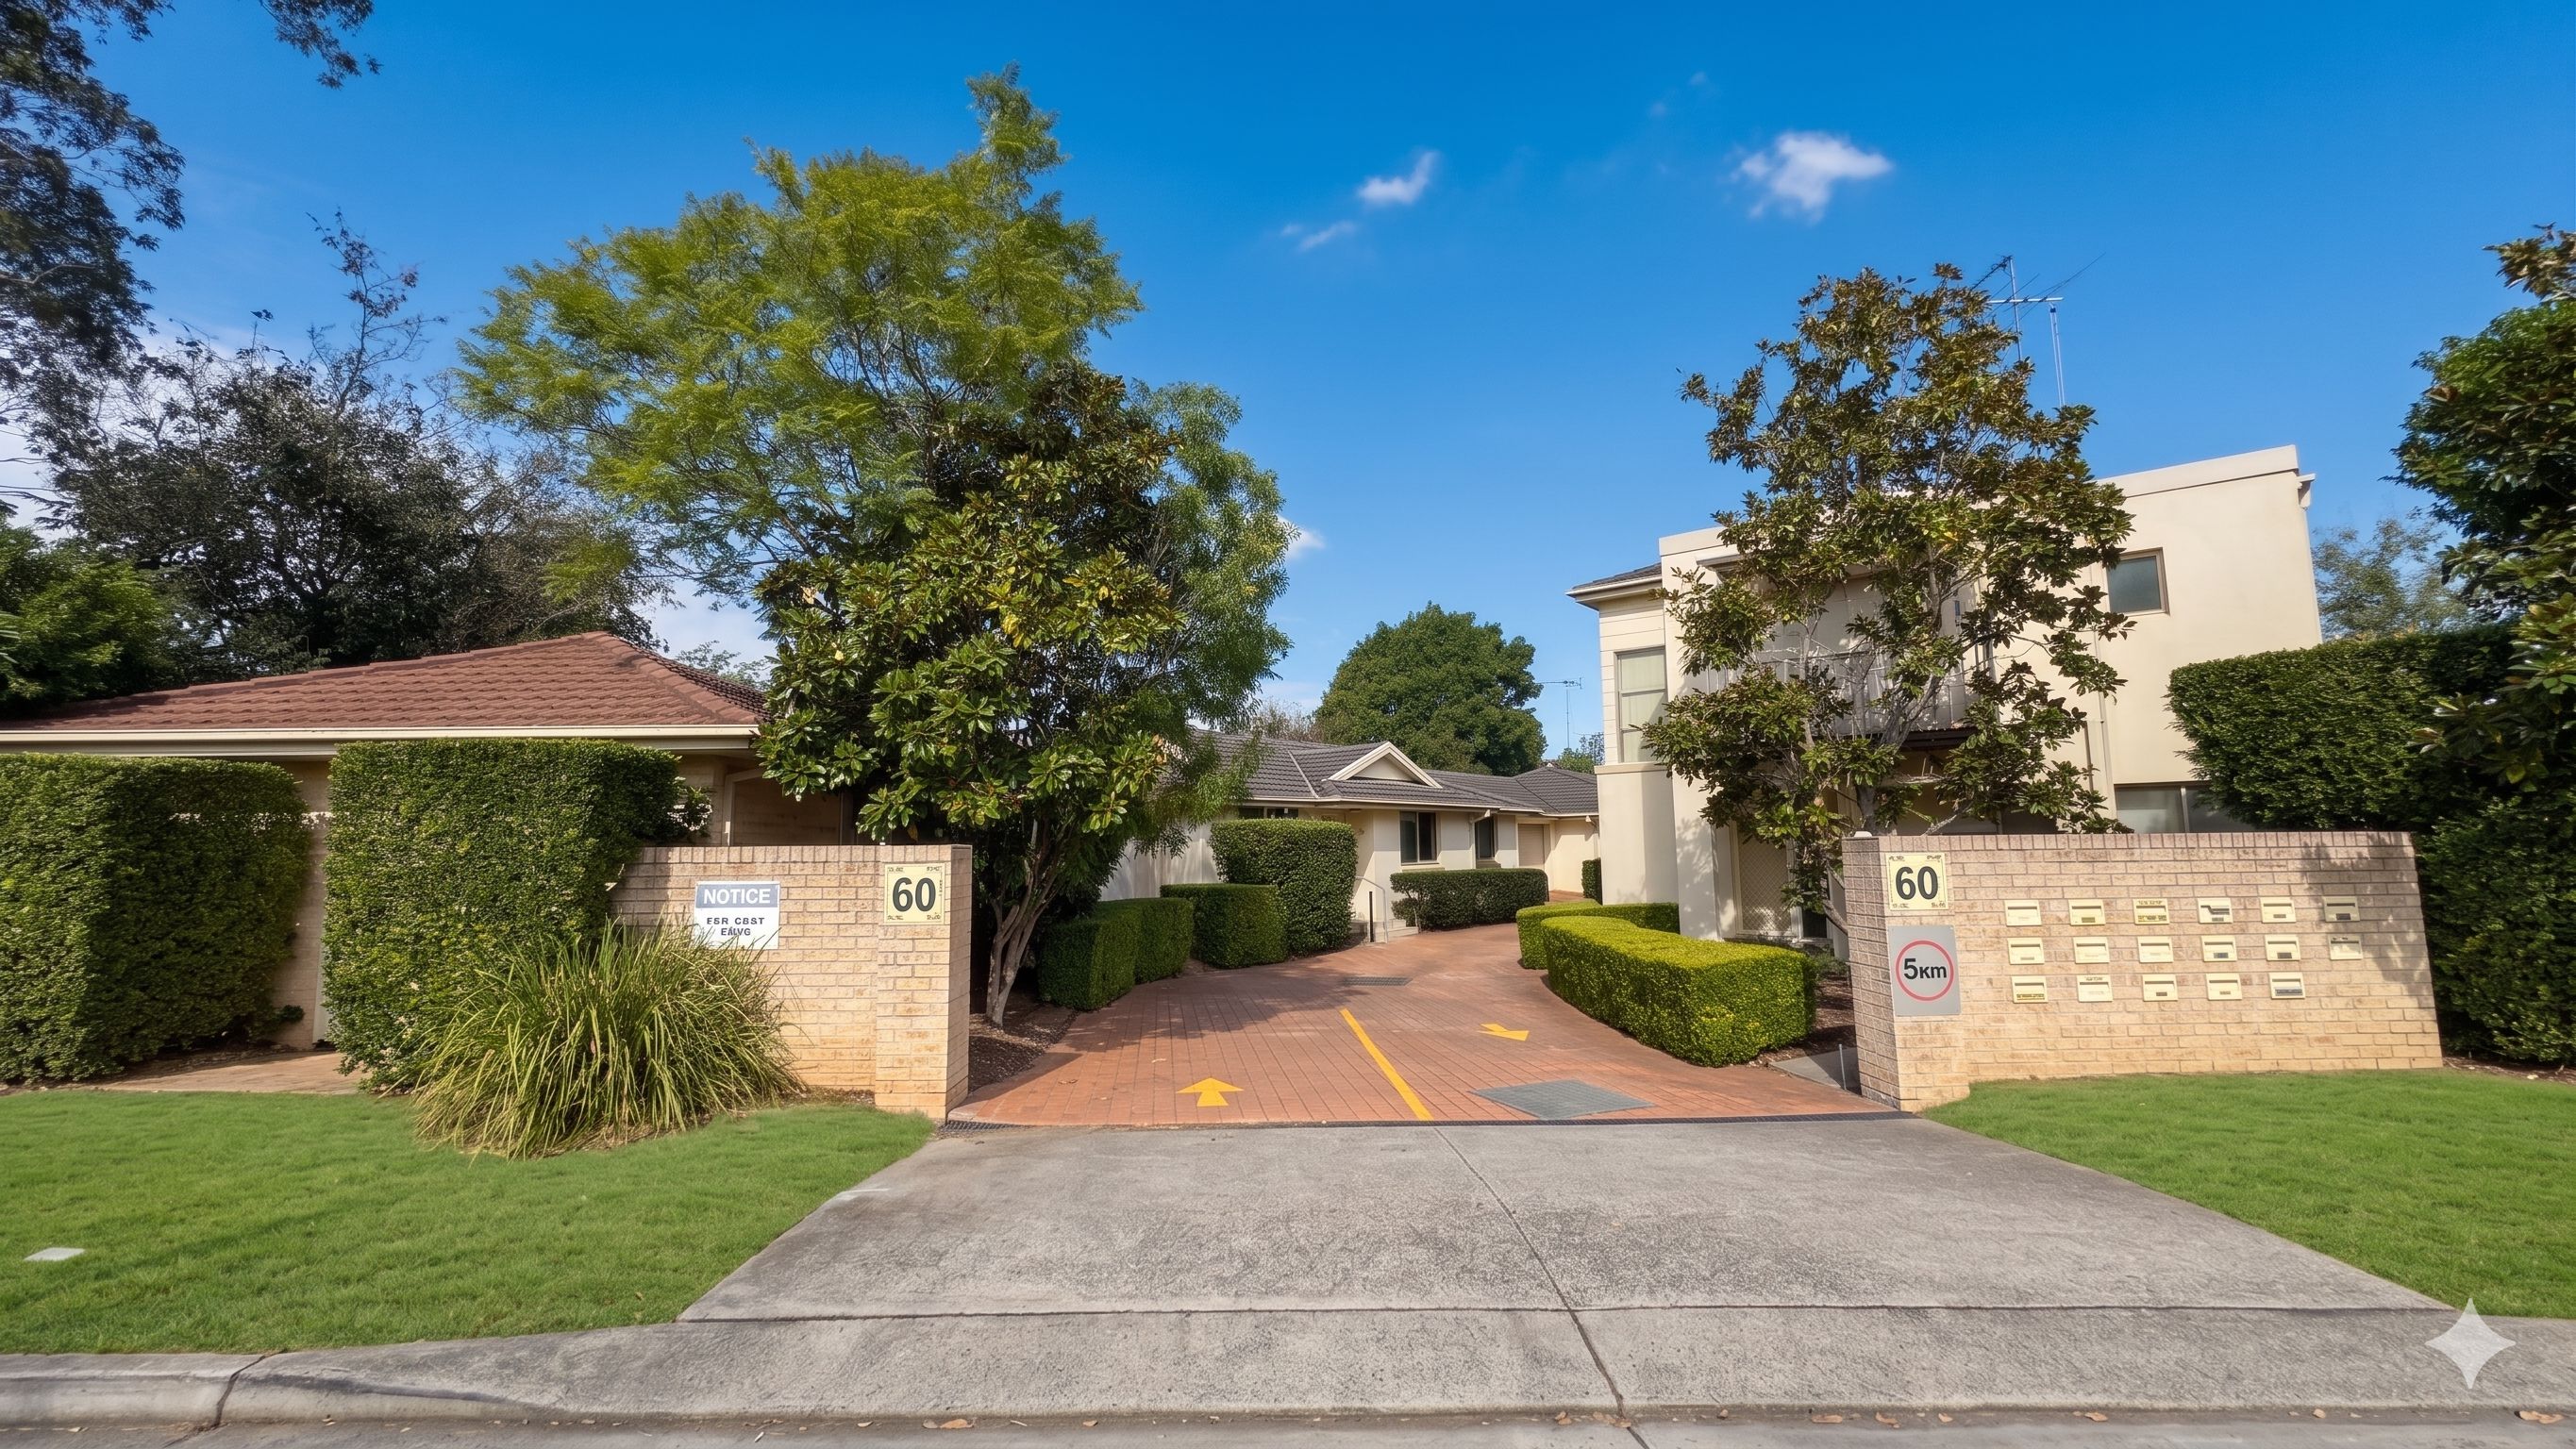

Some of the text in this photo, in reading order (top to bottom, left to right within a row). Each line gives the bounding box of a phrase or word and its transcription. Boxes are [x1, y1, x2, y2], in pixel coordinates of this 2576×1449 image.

[703, 889, 771, 905] NOTICE
[893, 877, 936, 912] 60
[1896, 866, 1938, 900] 60
